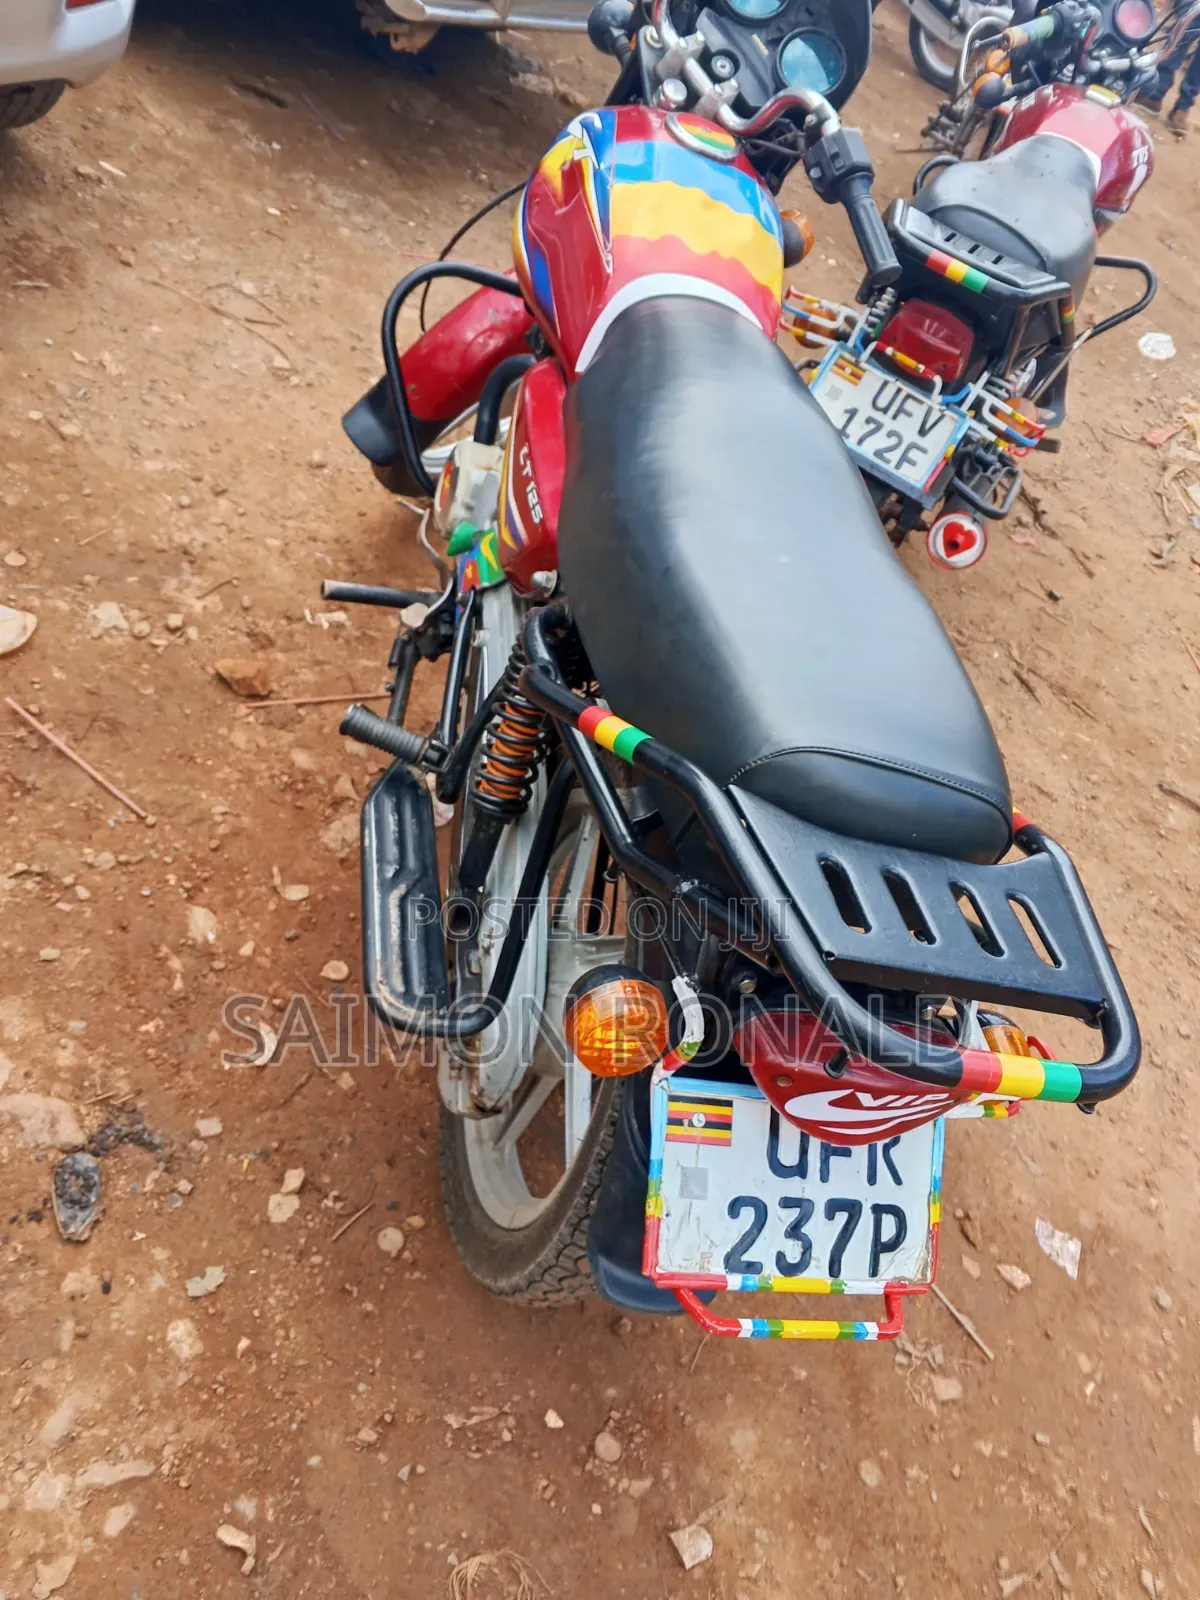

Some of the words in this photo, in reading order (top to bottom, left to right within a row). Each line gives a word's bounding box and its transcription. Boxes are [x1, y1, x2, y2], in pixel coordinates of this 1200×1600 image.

[871, 379, 946, 438] UFV
[838, 406, 929, 471] 172F
[526, 480, 544, 525] 125
[854, 1091, 950, 1108] VIP
[723, 1195, 908, 1278] 237P
